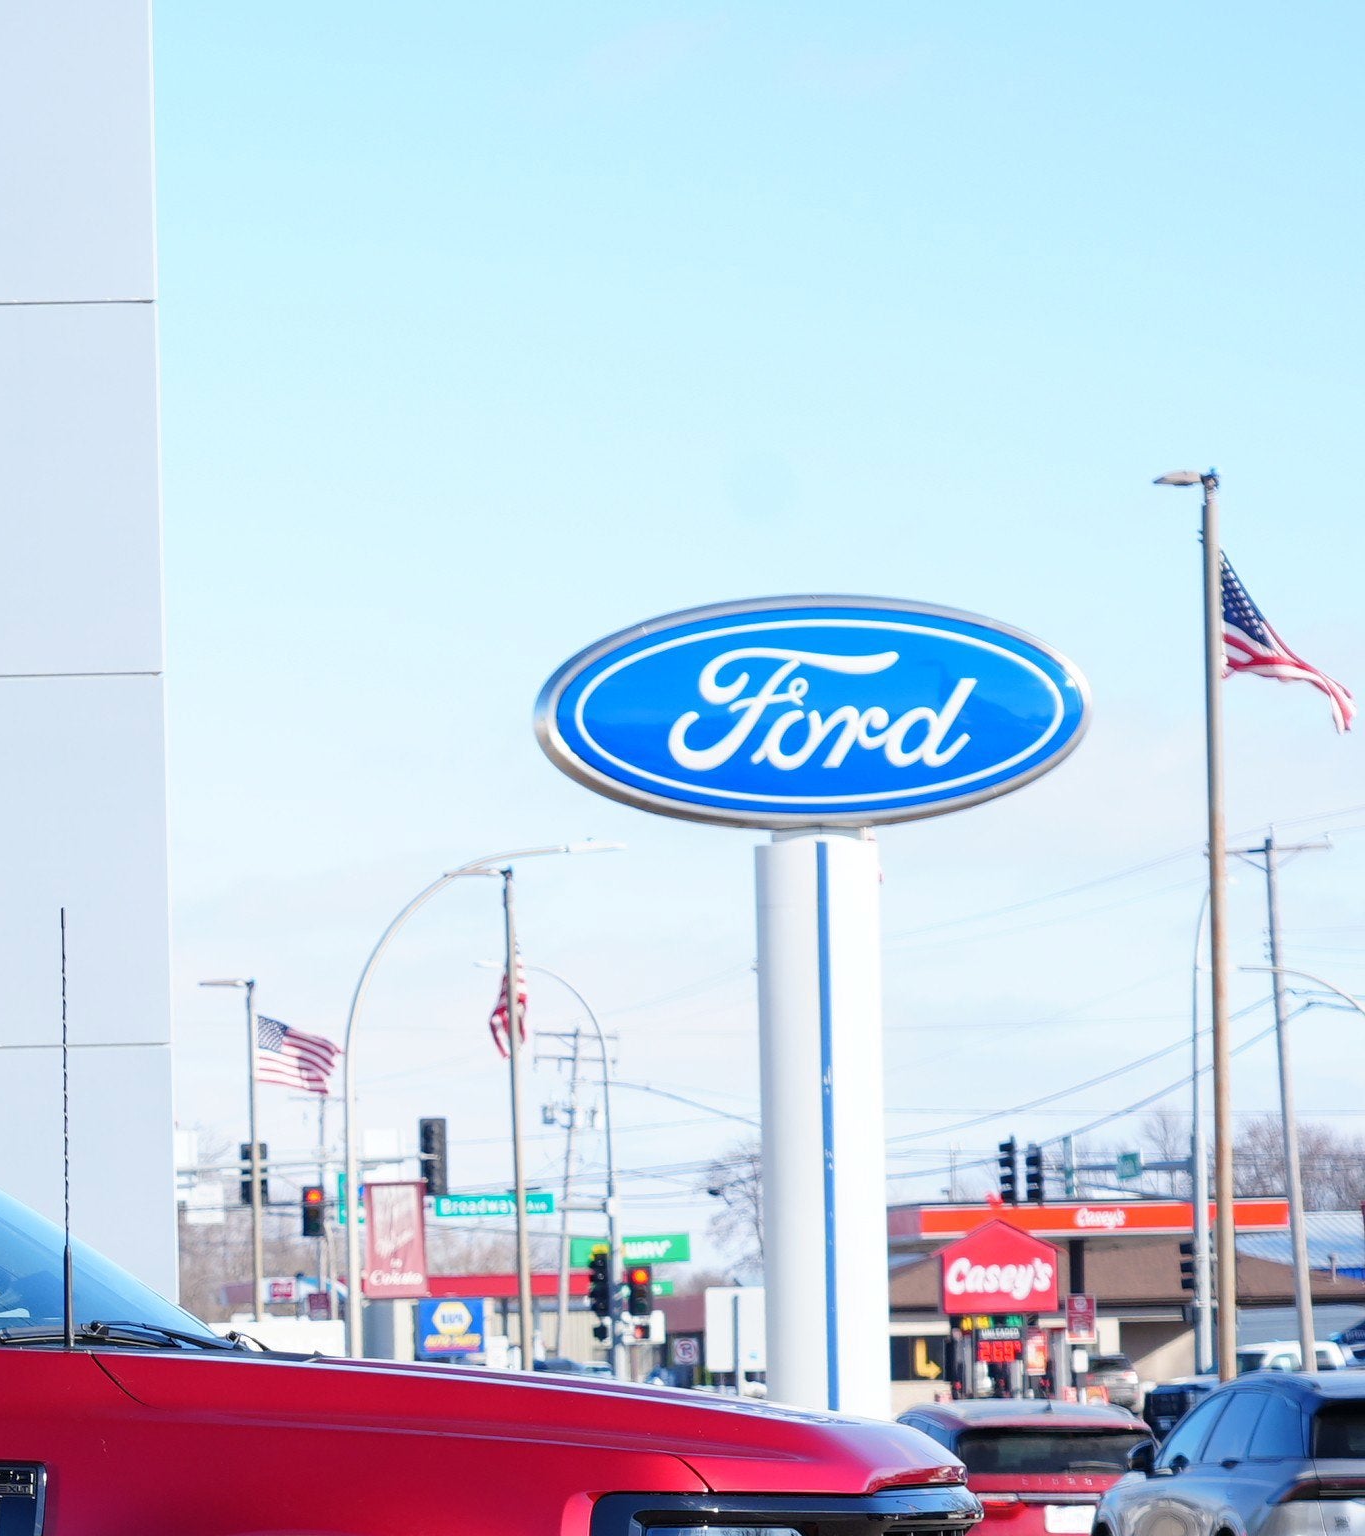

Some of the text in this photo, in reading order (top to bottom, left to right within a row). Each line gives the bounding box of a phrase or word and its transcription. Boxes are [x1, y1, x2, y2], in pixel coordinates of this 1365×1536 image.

[669, 647, 978, 771] Ford
[441, 1198, 517, 1215] Broadway
[1075, 1207, 1126, 1229] Casey's
[947, 1257, 1053, 1300] Casey's
[7, 1485, 29, 1493] XLT
